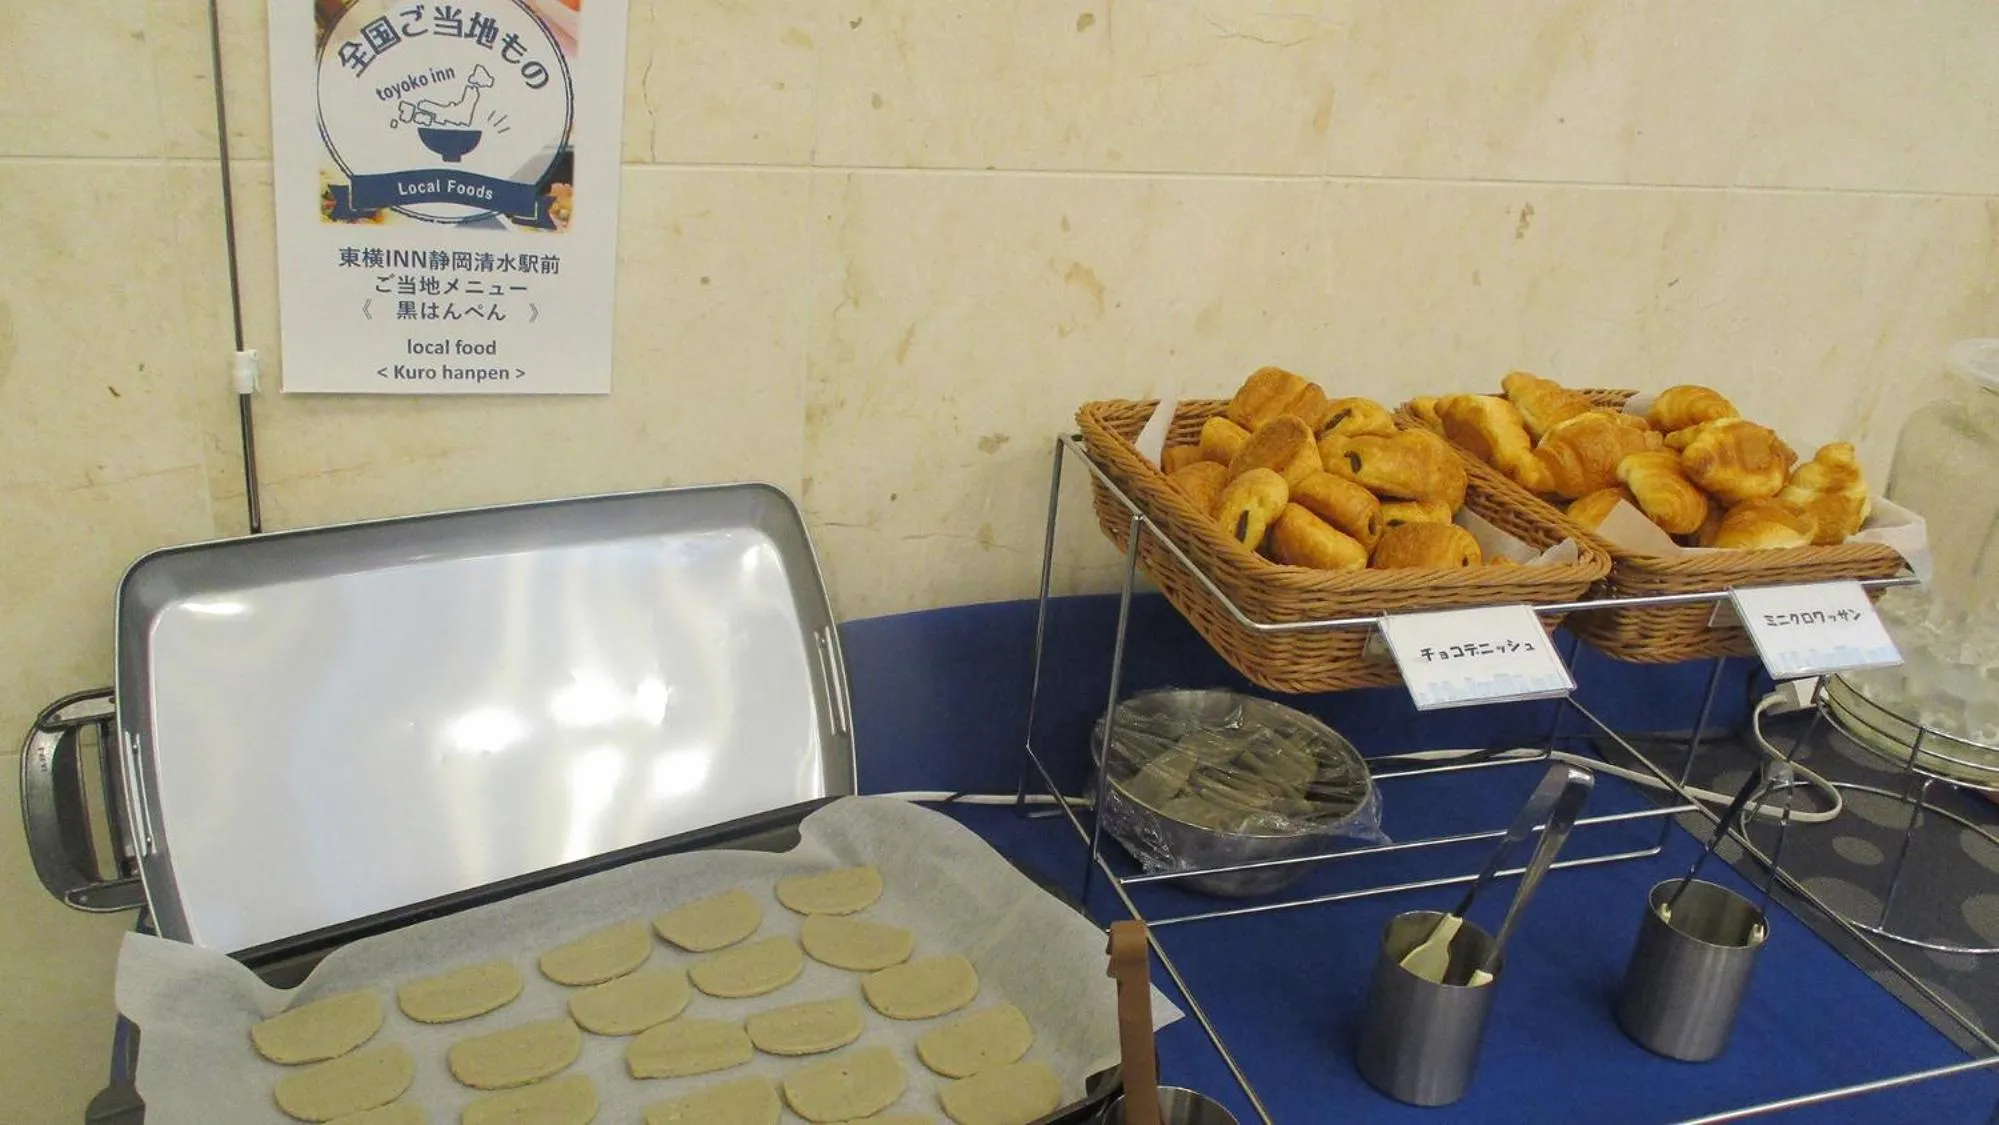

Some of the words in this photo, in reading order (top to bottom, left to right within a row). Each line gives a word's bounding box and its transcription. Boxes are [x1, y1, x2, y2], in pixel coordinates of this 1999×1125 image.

[338, 5, 549, 90] 全国ご当地もの
[376, 71, 428, 101] toyoko
[430, 67, 455, 84] inn
[397, 180, 441, 196] Local
[447, 180, 493, 200] Foods
[338, 247, 560, 275] 東横INN静岡清水駅前
[375, 273, 528, 296] ご当地メニュー
[407, 339, 449, 355] local
[455, 340, 496, 356] food
[394, 365, 436, 380] Kuro
[442, 365, 509, 383] hanpen
[1764, 609, 1862, 627] ミニクロワッサン
